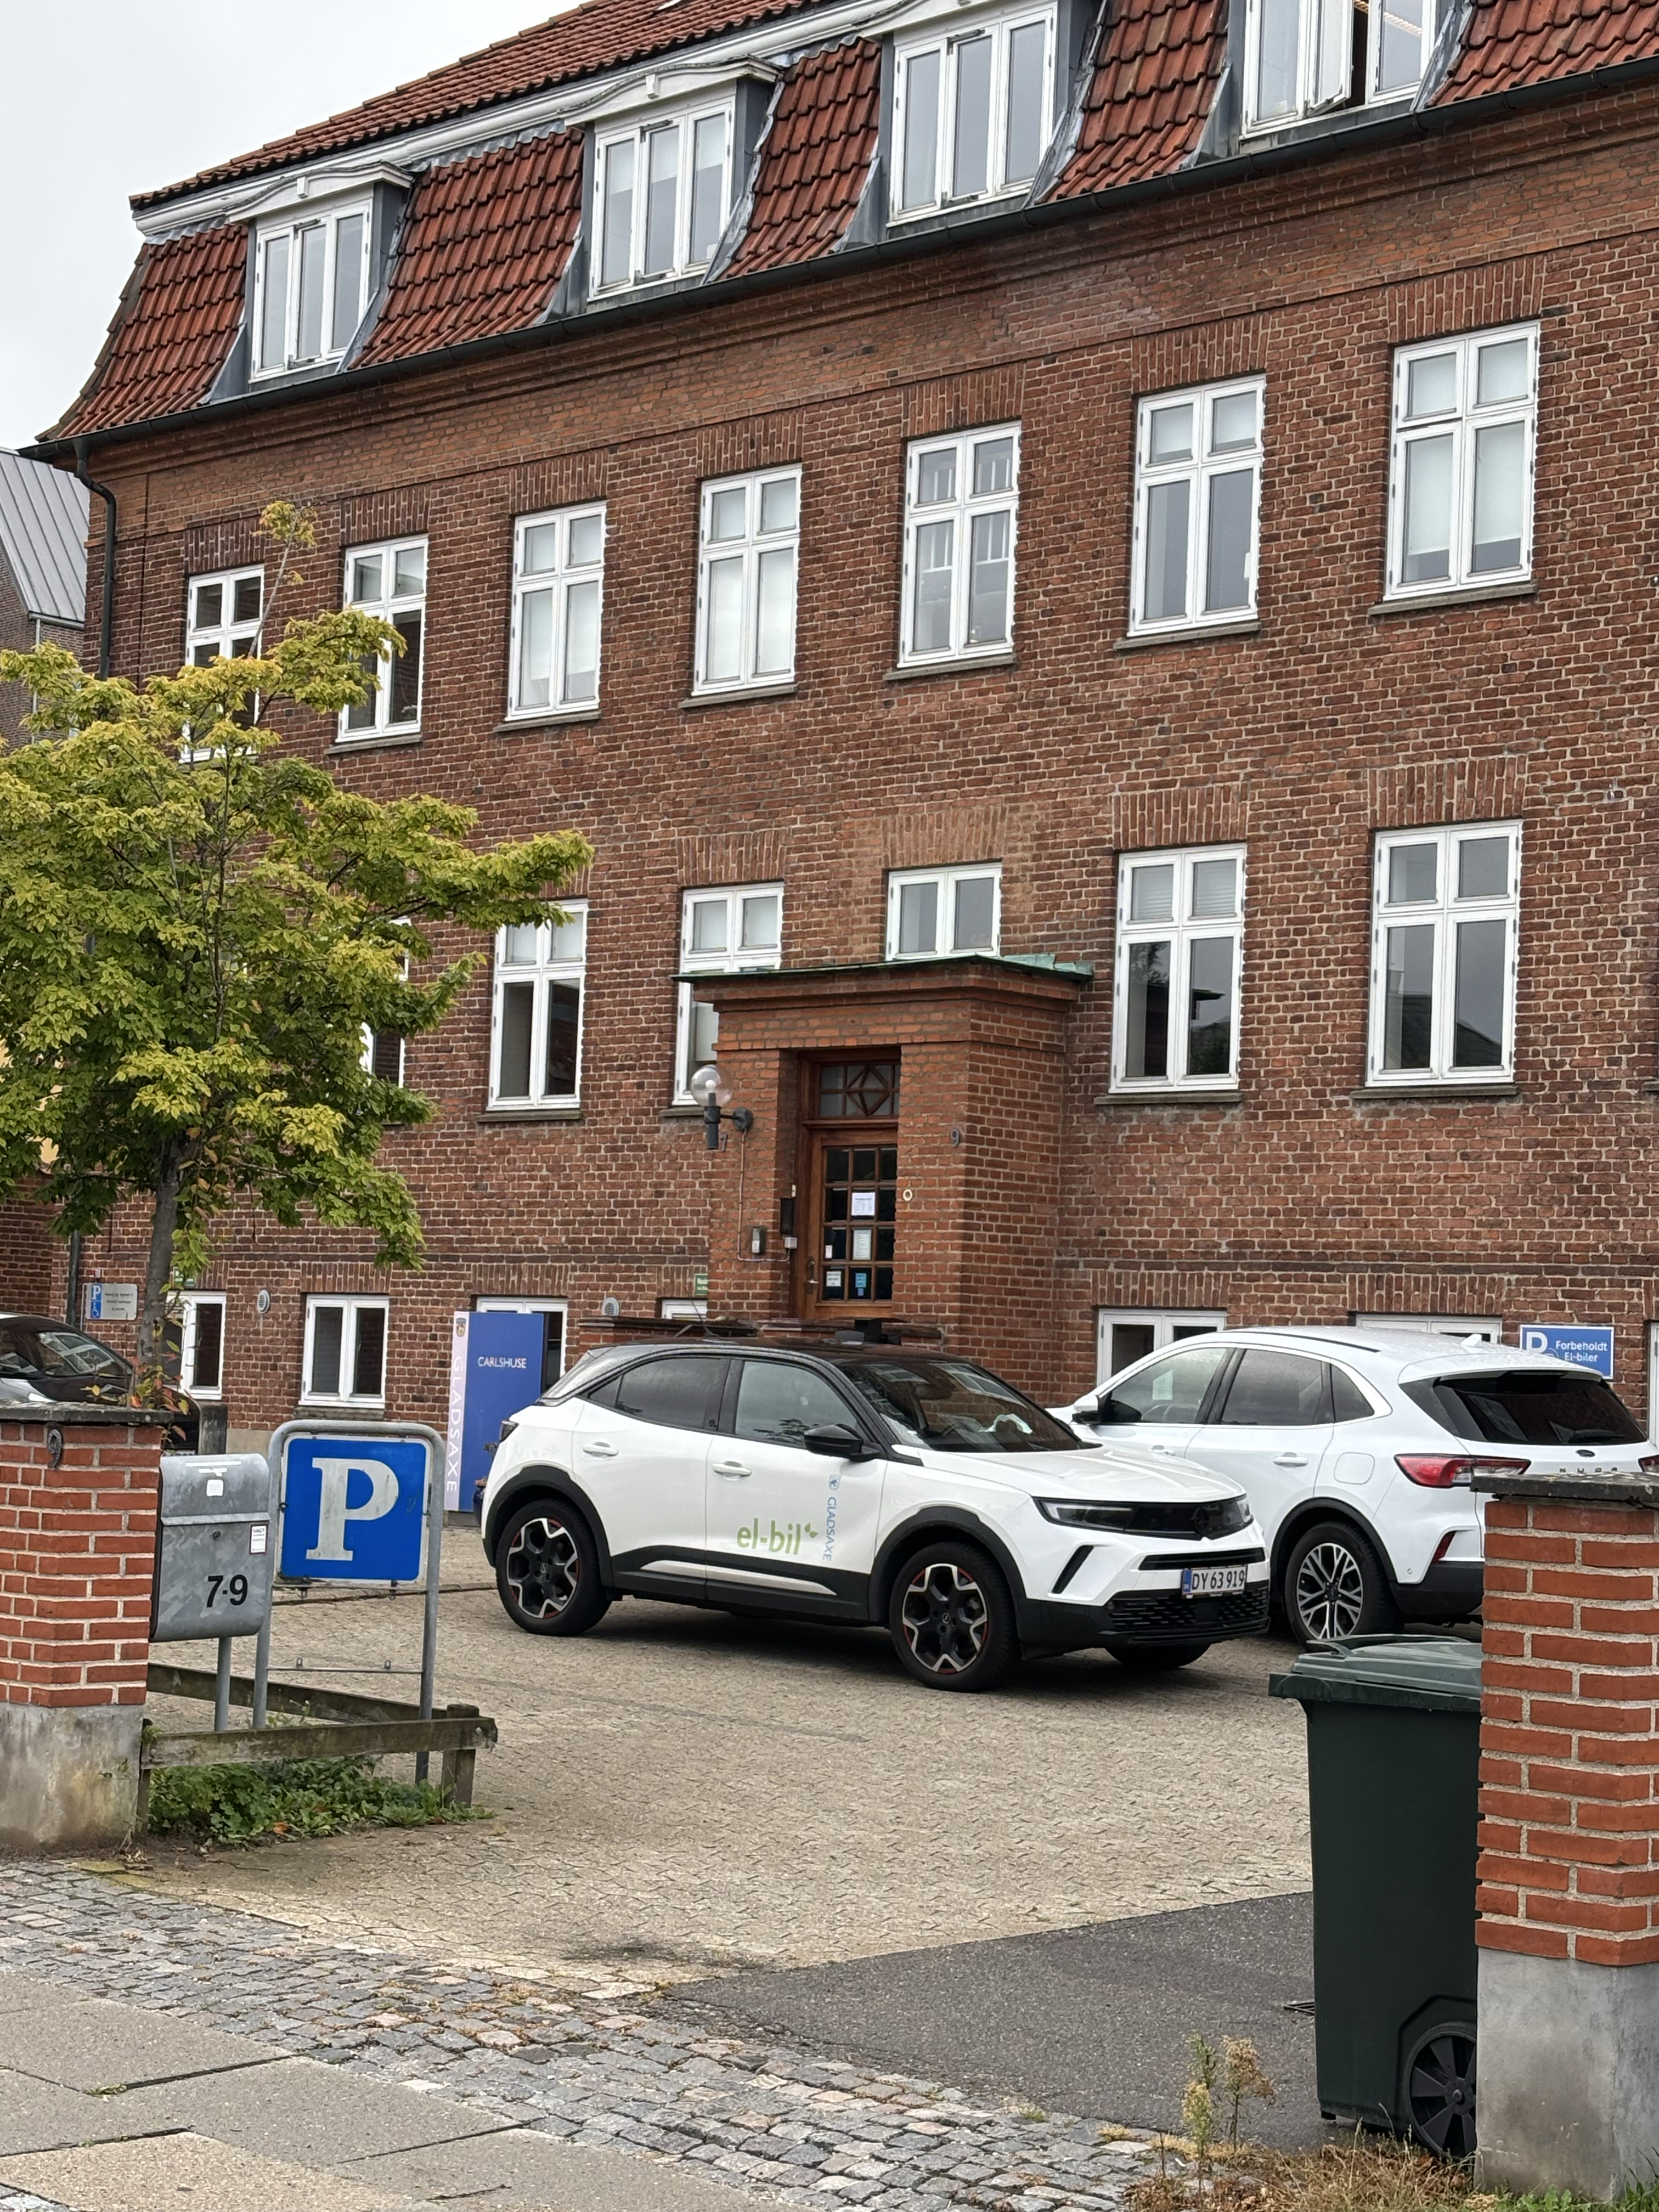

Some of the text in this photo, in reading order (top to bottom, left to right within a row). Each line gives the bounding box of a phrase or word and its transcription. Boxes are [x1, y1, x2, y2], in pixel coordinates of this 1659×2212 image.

[92, 1285, 101, 1300] P
[477, 1356, 527, 1369] CARLSHUSE
[1555, 1340, 1608, 1352] Forbeholdt
[1565, 1352, 1599, 1362] El-biler
[446, 1356, 464, 1493] GLADSAXE
[48, 1428, 62, 1469] 9
[306, 1457, 399, 1561] P
[736, 1517, 802, 1556] el-bil
[822, 1496, 837, 1562] GLADSAXE
[206, 1574, 248, 1608] 7-9
[1192, 1572, 1209, 1590] DY
[1210, 1571, 1224, 1589] 63
[1226, 1569, 1245, 1588] 919
